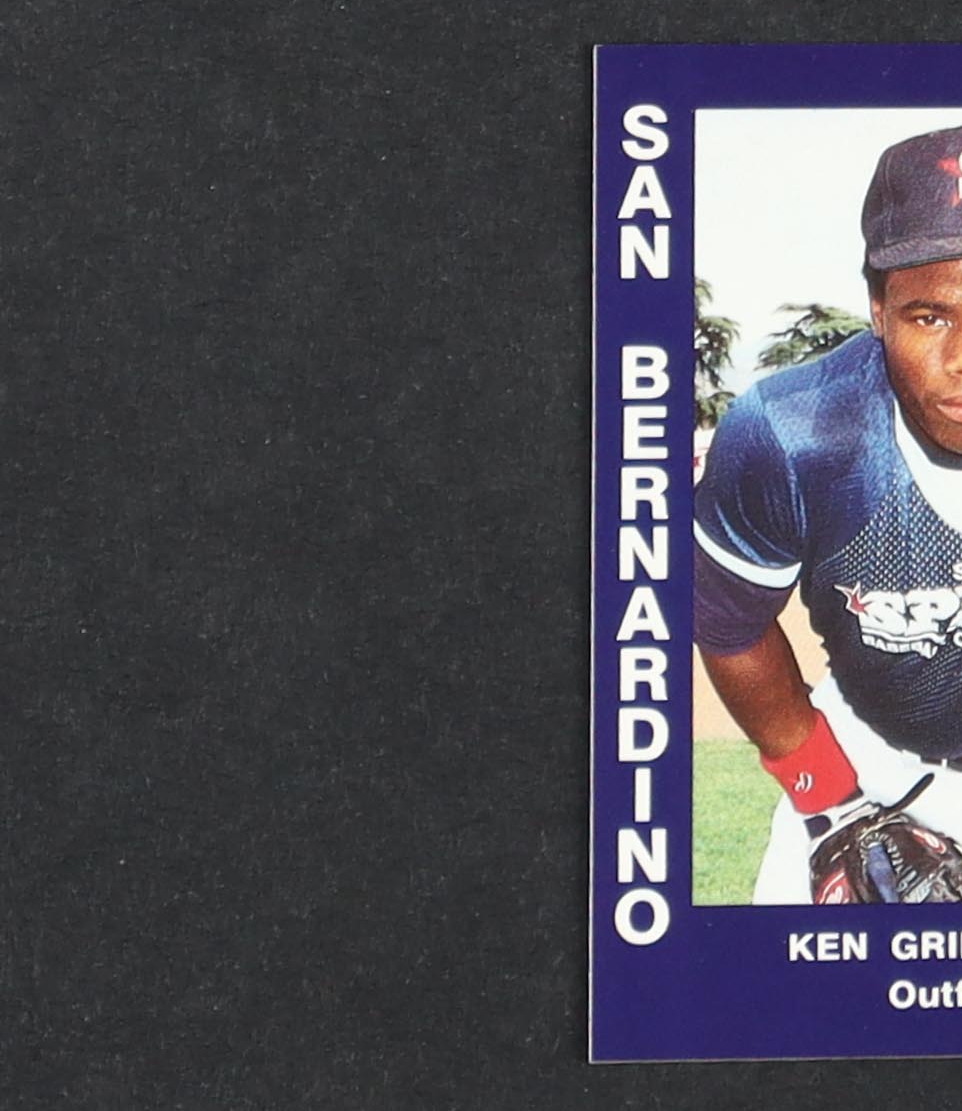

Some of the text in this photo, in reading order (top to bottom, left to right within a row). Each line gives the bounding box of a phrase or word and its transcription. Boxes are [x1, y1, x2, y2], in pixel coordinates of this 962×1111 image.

[614, 104, 672, 945] SAN BERNARDINO
[789, 932, 868, 962] KEN
